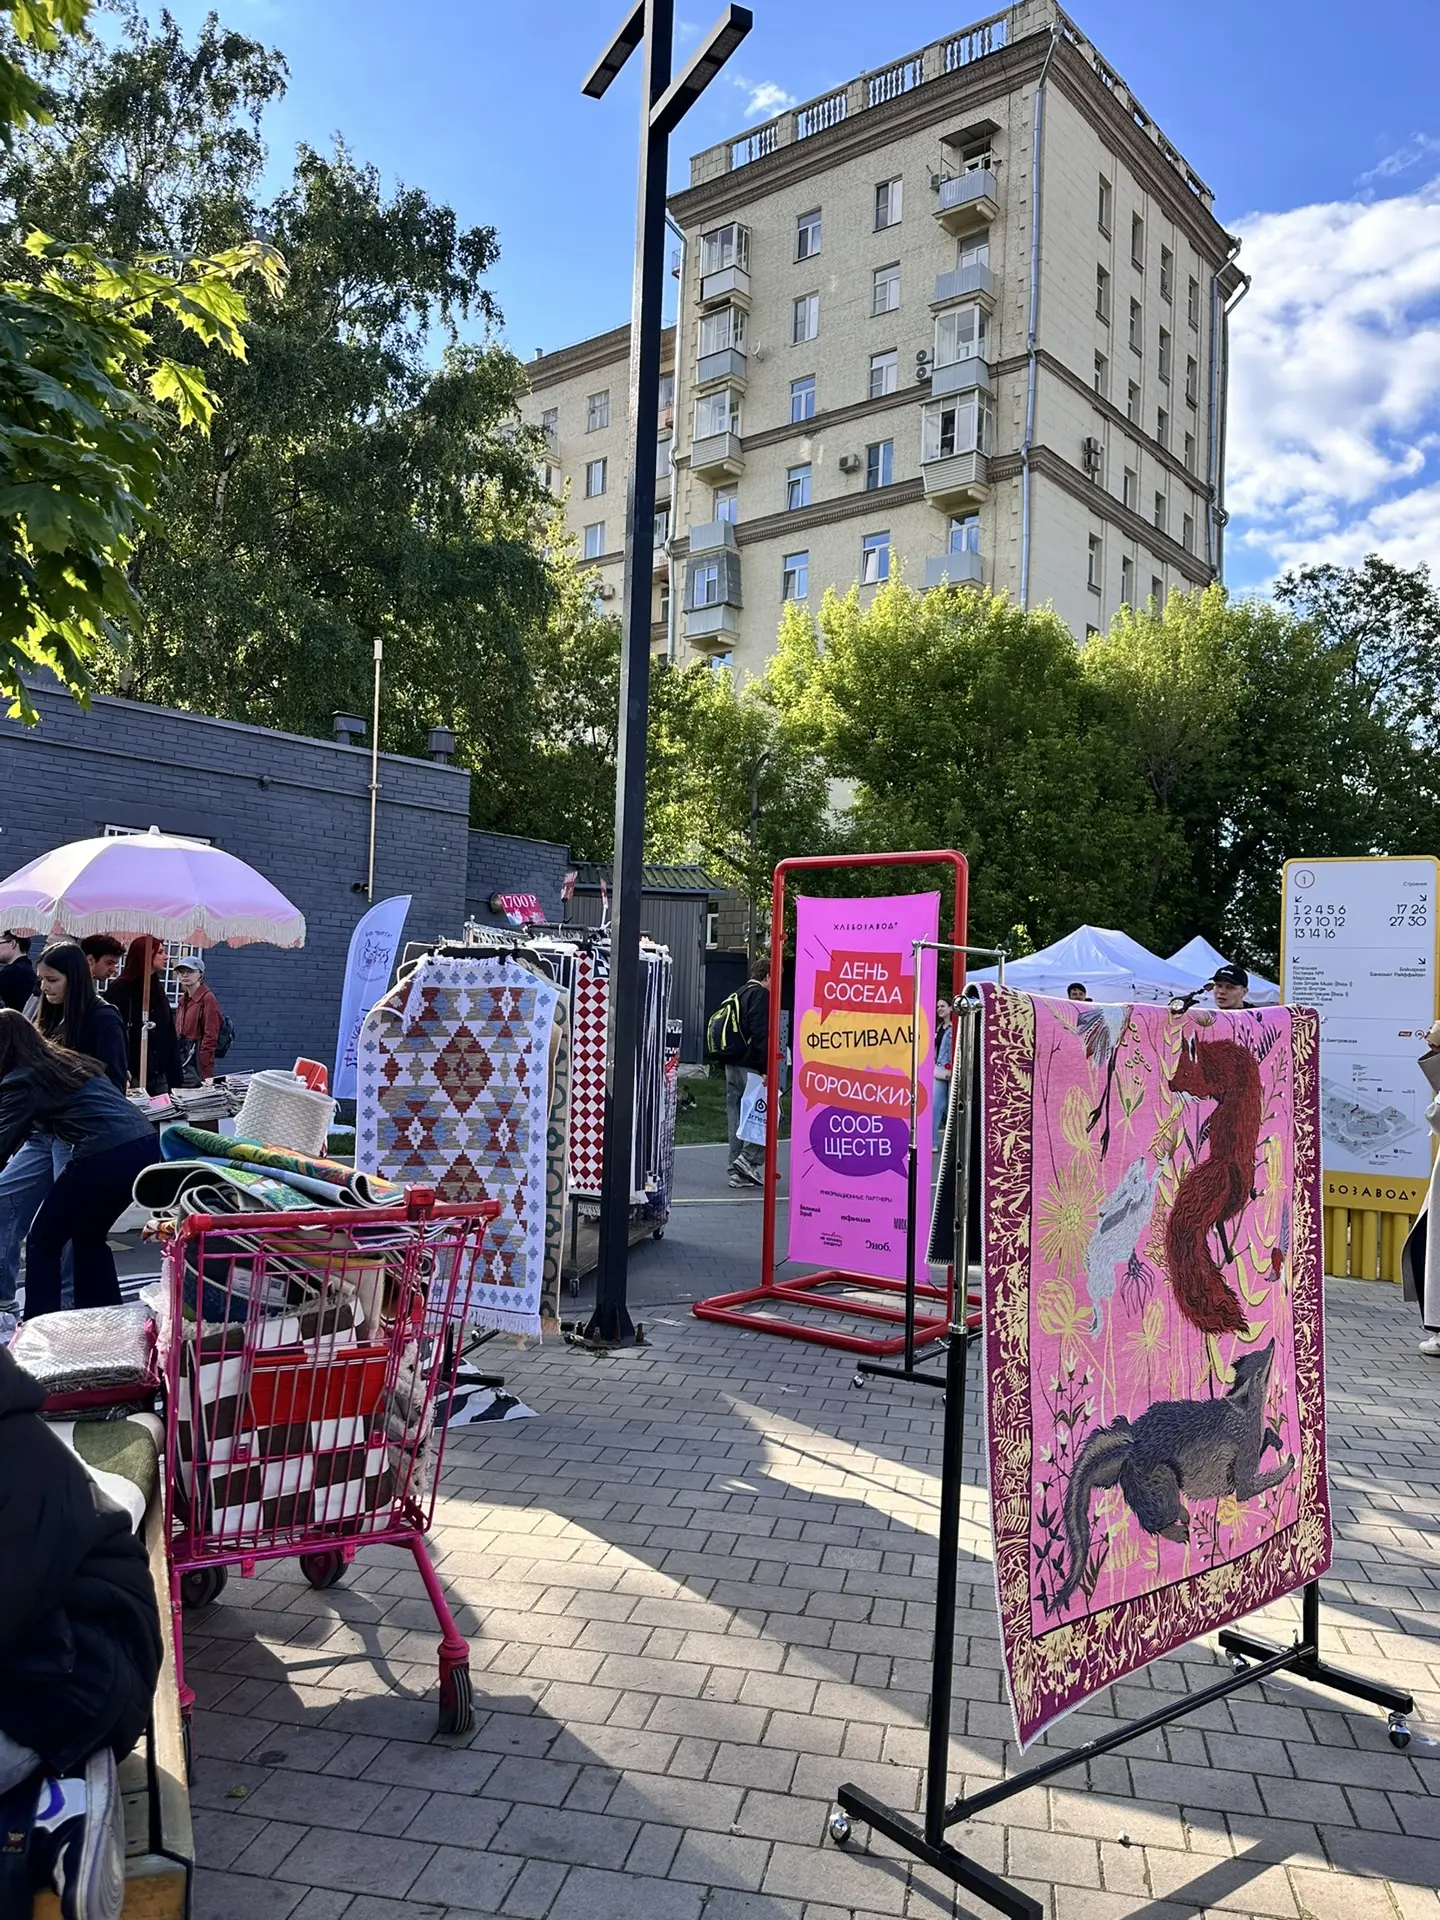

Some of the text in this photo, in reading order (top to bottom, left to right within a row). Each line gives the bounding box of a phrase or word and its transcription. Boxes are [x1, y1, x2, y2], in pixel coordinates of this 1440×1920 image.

[1293, 904, 1347, 915] 1 2 4 5 6
[1396, 904, 1427, 915] 17 26
[1293, 916, 1346, 927] 7 9 10 12
[1389, 916, 1427, 927] 27 30
[1294, 928, 1336, 939] 13 14 16
[839, 961, 889, 981] ДЕНЬ
[823, 981, 903, 1004] СОСЕДА
[806, 1025, 920, 1049] ФЕСТИВАЛЬ
[829, 1115, 884, 1134] СООБ
[824, 1137, 892, 1160] ЩЕСТВ
[820, 1190, 864, 1200] ИНФОРМАЦИОННЫЕ
[840, 1214, 871, 1224] афиша
